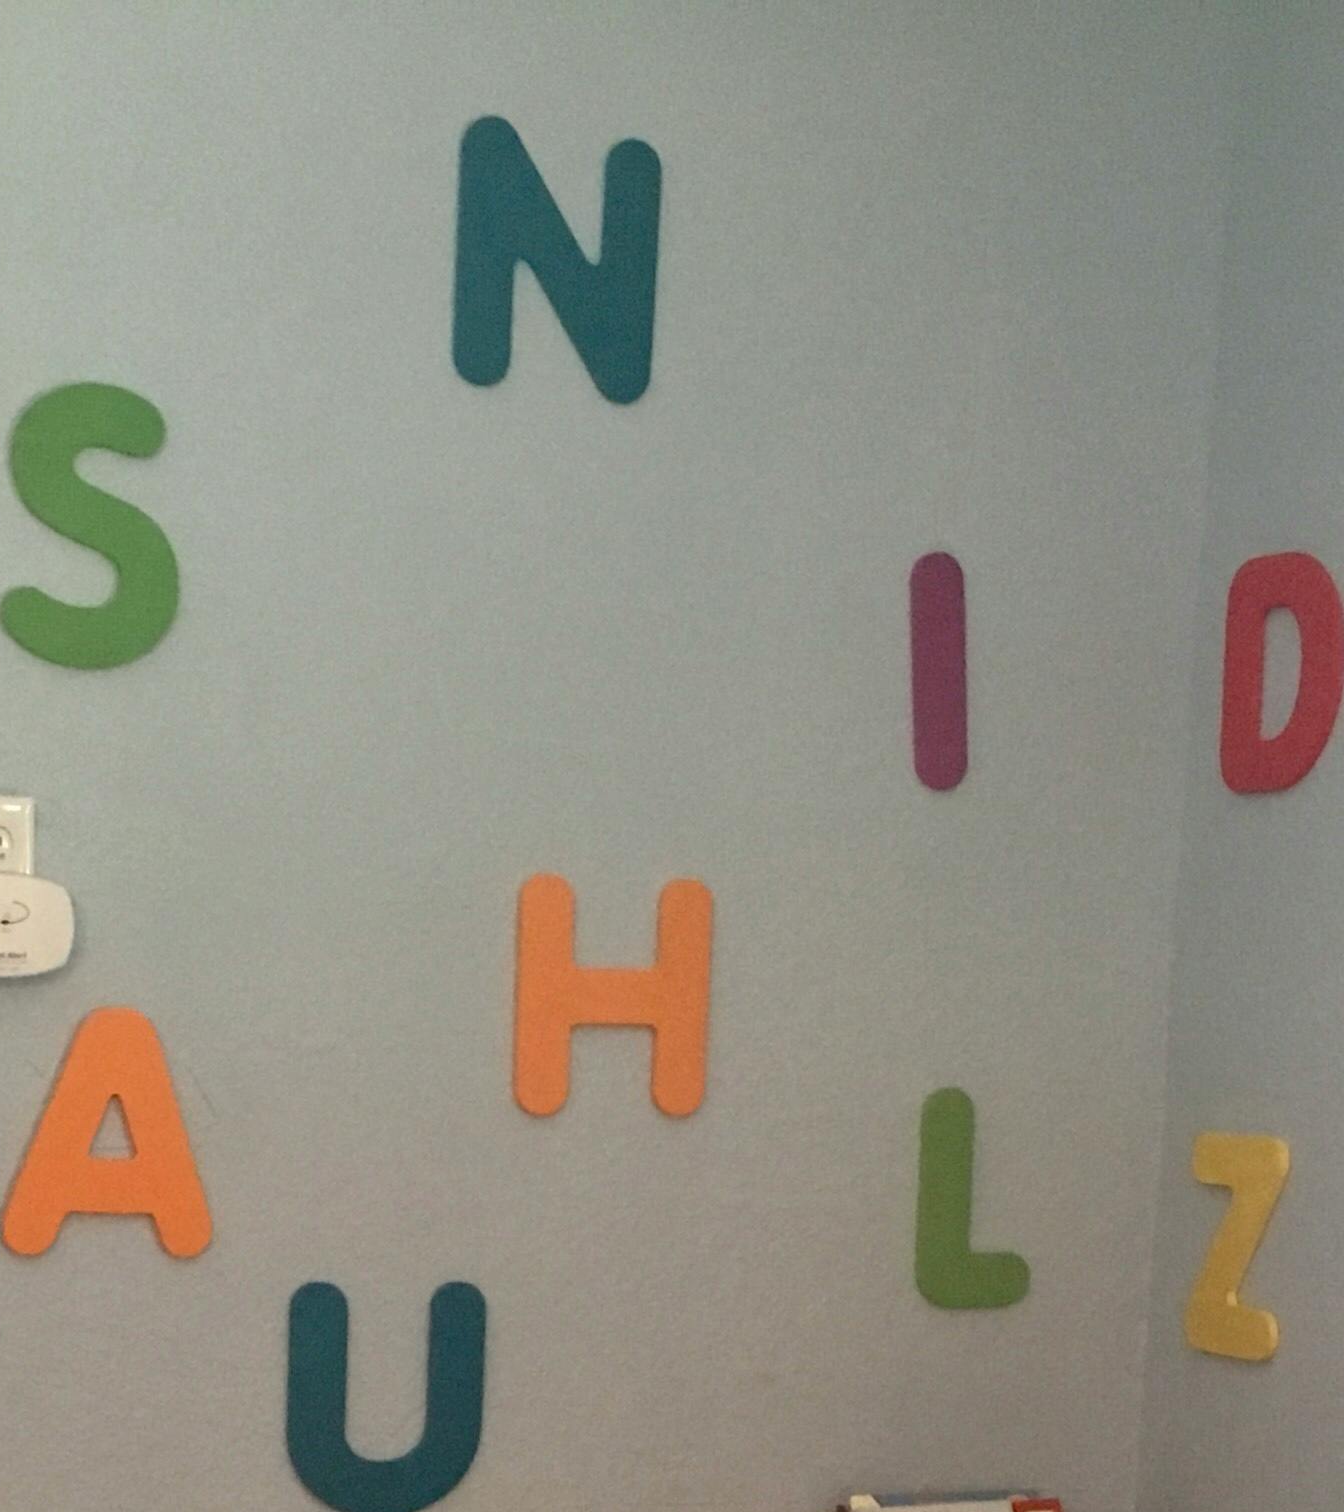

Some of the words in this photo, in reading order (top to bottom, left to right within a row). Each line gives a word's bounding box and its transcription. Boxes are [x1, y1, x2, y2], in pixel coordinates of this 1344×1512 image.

[452, 116, 661, 405] N
[1, 383, 179, 668] S
[913, 553, 967, 790] I
[1220, 553, 1343, 794] D
[513, 873, 713, 1116] H
[2, 1008, 212, 1257] A
[915, 1088, 1029, 1309] L
[1189, 1132, 1294, 1360] Z
